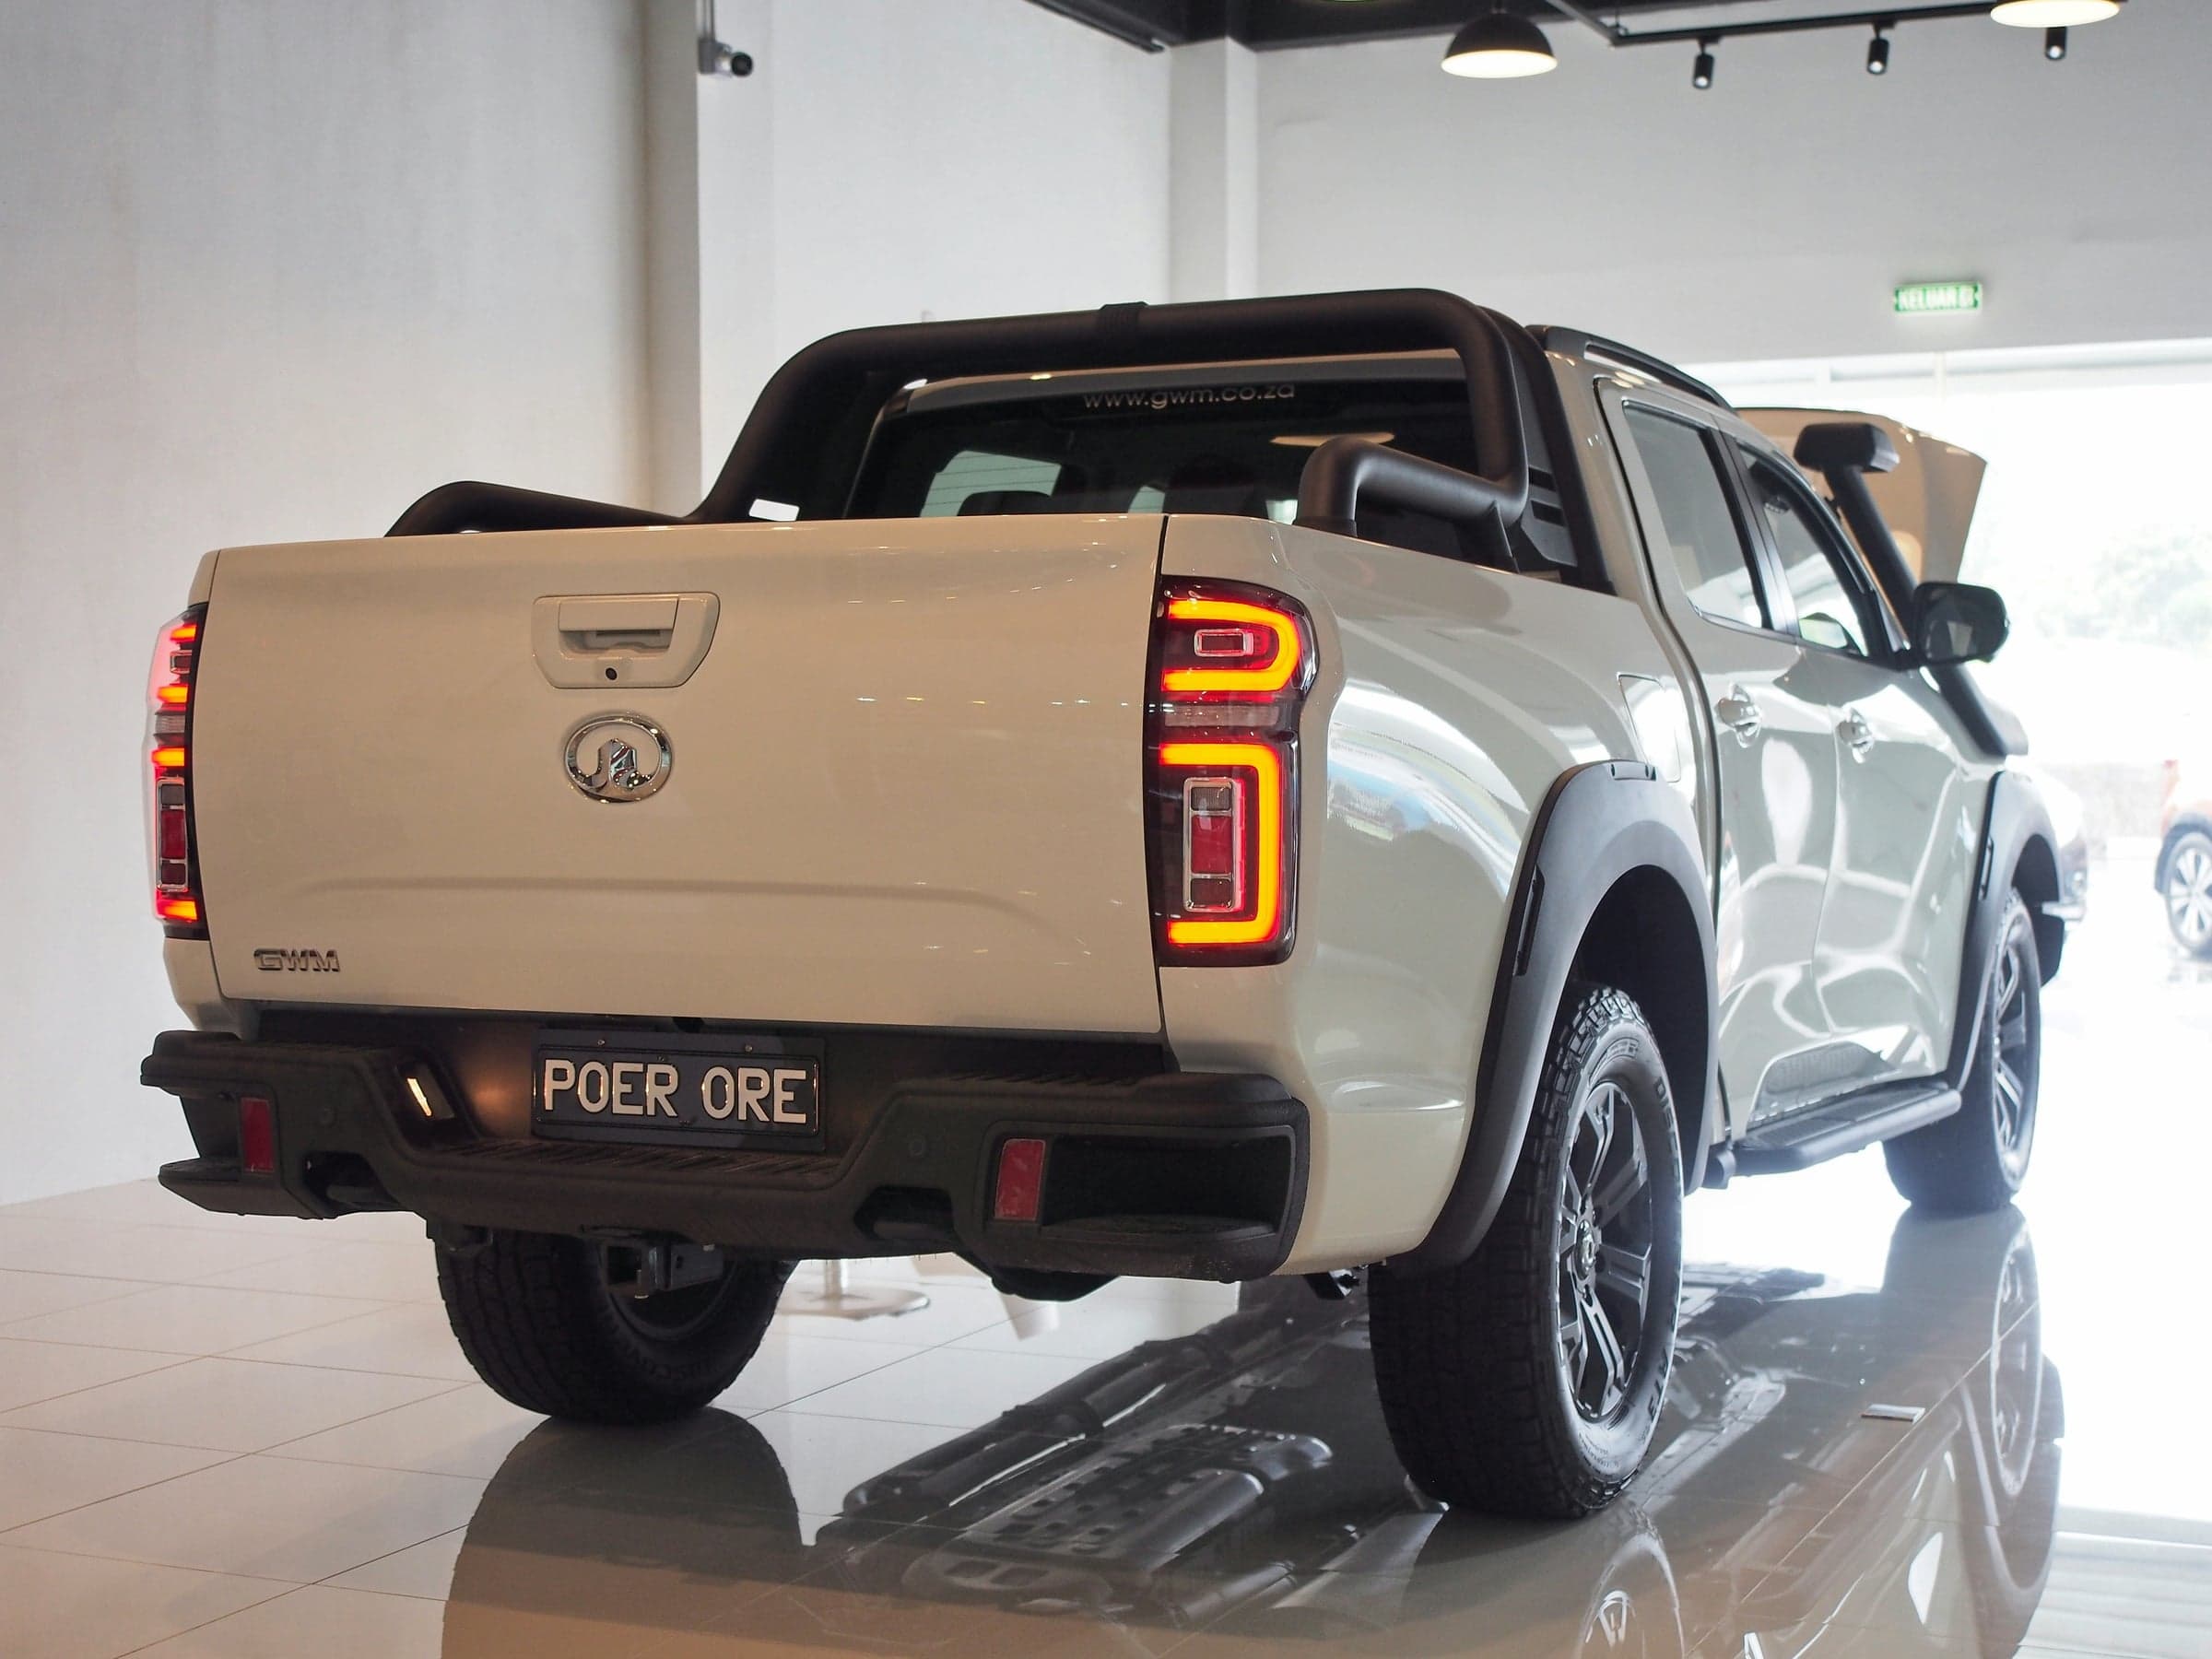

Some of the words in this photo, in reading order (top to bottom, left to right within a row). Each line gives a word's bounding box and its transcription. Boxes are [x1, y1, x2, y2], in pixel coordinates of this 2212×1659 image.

[1083, 382, 1296, 409] www.gwm.co.za
[253, 947, 341, 972] GWM
[543, 1058, 679, 1117] POER
[700, 1065, 807, 1124] ORE
